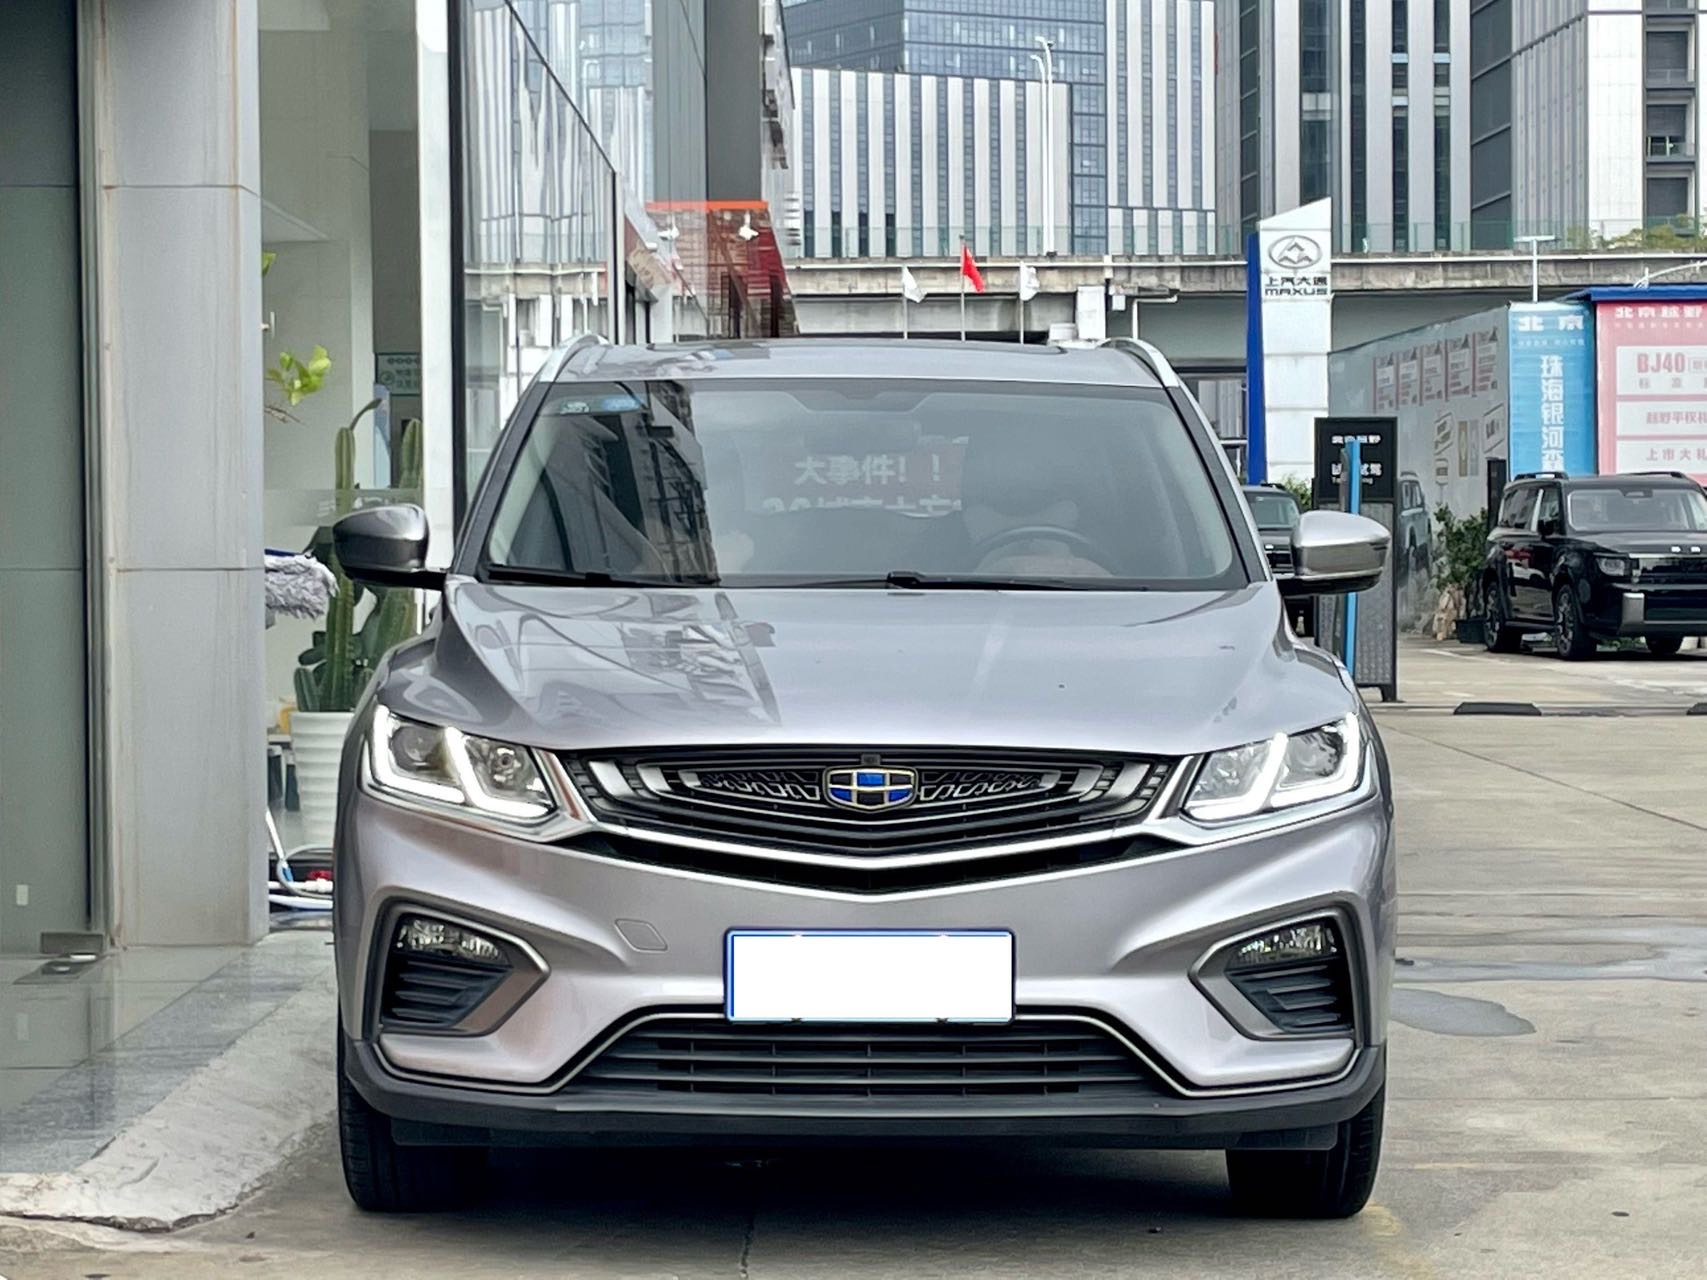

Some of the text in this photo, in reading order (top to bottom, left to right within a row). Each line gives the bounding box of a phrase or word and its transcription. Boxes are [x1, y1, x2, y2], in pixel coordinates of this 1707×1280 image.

[1264, 276, 1328, 287] 上汽大通
[1264, 288, 1328, 296] MAXUS
[1518, 315, 1585, 331] 北京
[1636, 352, 1686, 373] BJ40
